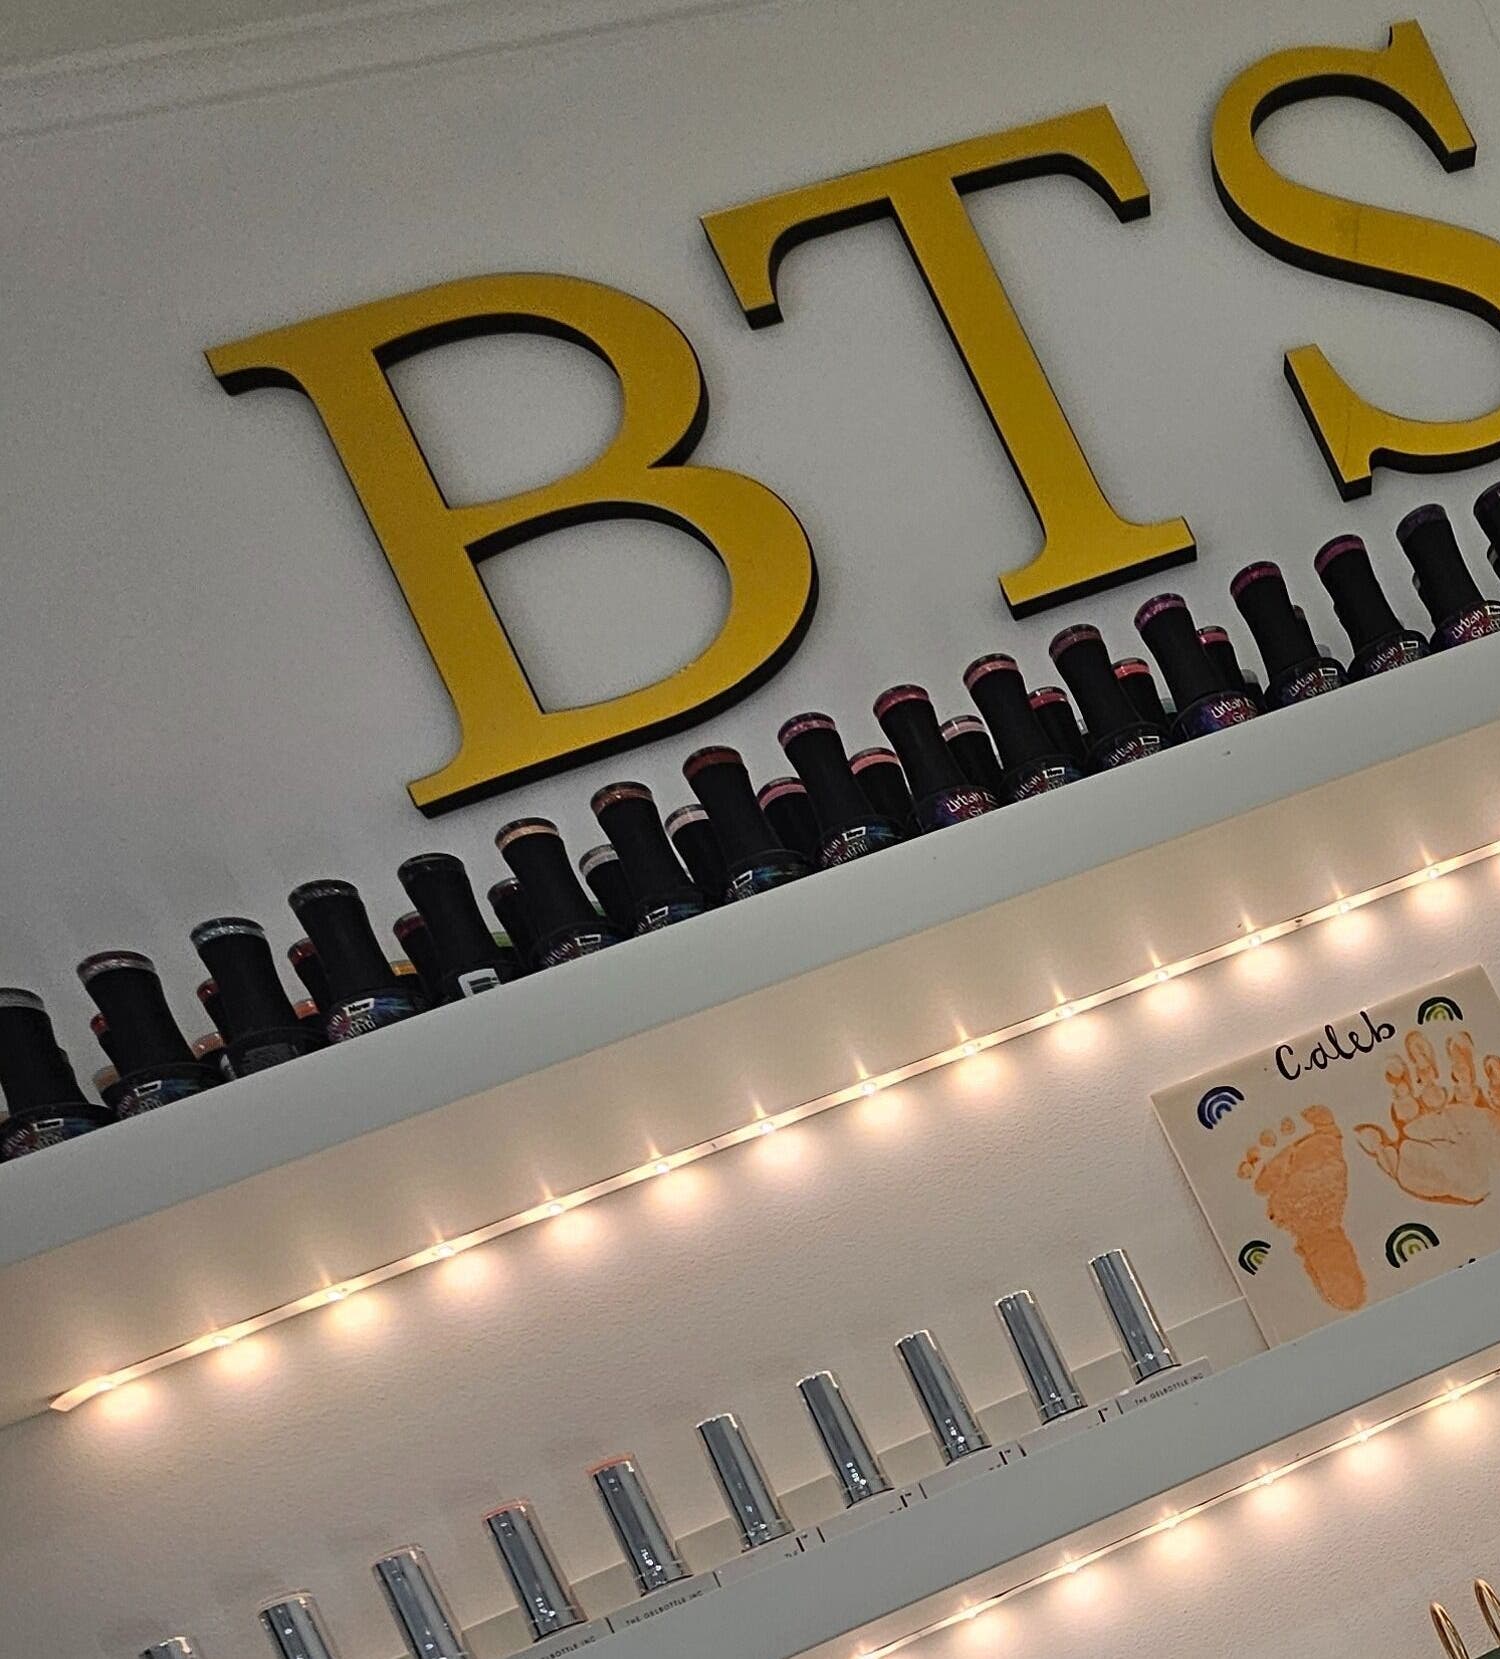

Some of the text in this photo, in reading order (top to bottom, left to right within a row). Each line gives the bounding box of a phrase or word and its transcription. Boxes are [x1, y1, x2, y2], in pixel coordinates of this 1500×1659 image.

[1451, 608, 1484, 639] Urban
[1370, 647, 1399, 673] Urban
[1288, 671, 1318, 697] Urban
[1211, 697, 1245, 719] Urban
[1108, 739, 1138, 767] Urban
[946, 791, 983, 813] Urban
[1275, 1010, 1396, 1081] Caleb
